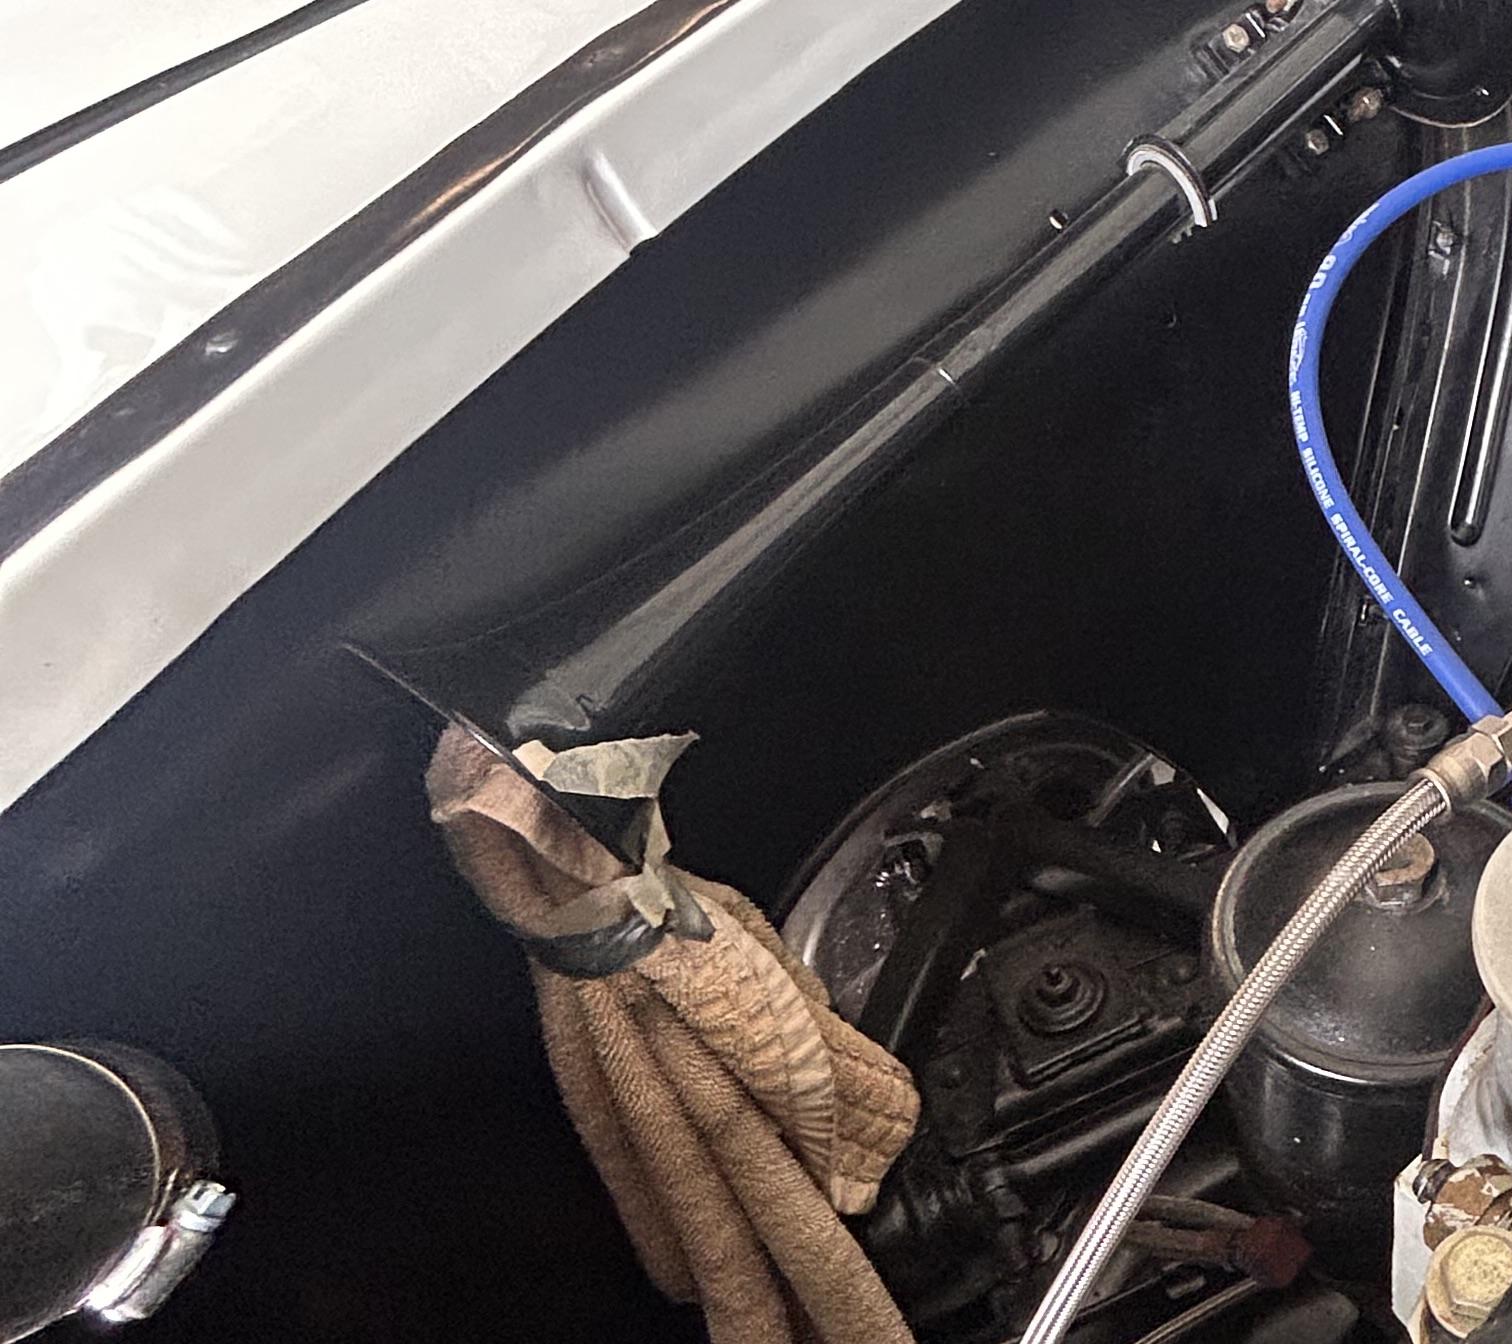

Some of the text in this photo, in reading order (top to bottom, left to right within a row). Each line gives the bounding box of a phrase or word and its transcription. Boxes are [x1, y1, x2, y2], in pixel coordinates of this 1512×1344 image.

[1302, 447, 1335, 510] SILICONE
[1330, 513, 1395, 605] SPIRAL-CORE
[1392, 608, 1434, 657] CABLE
